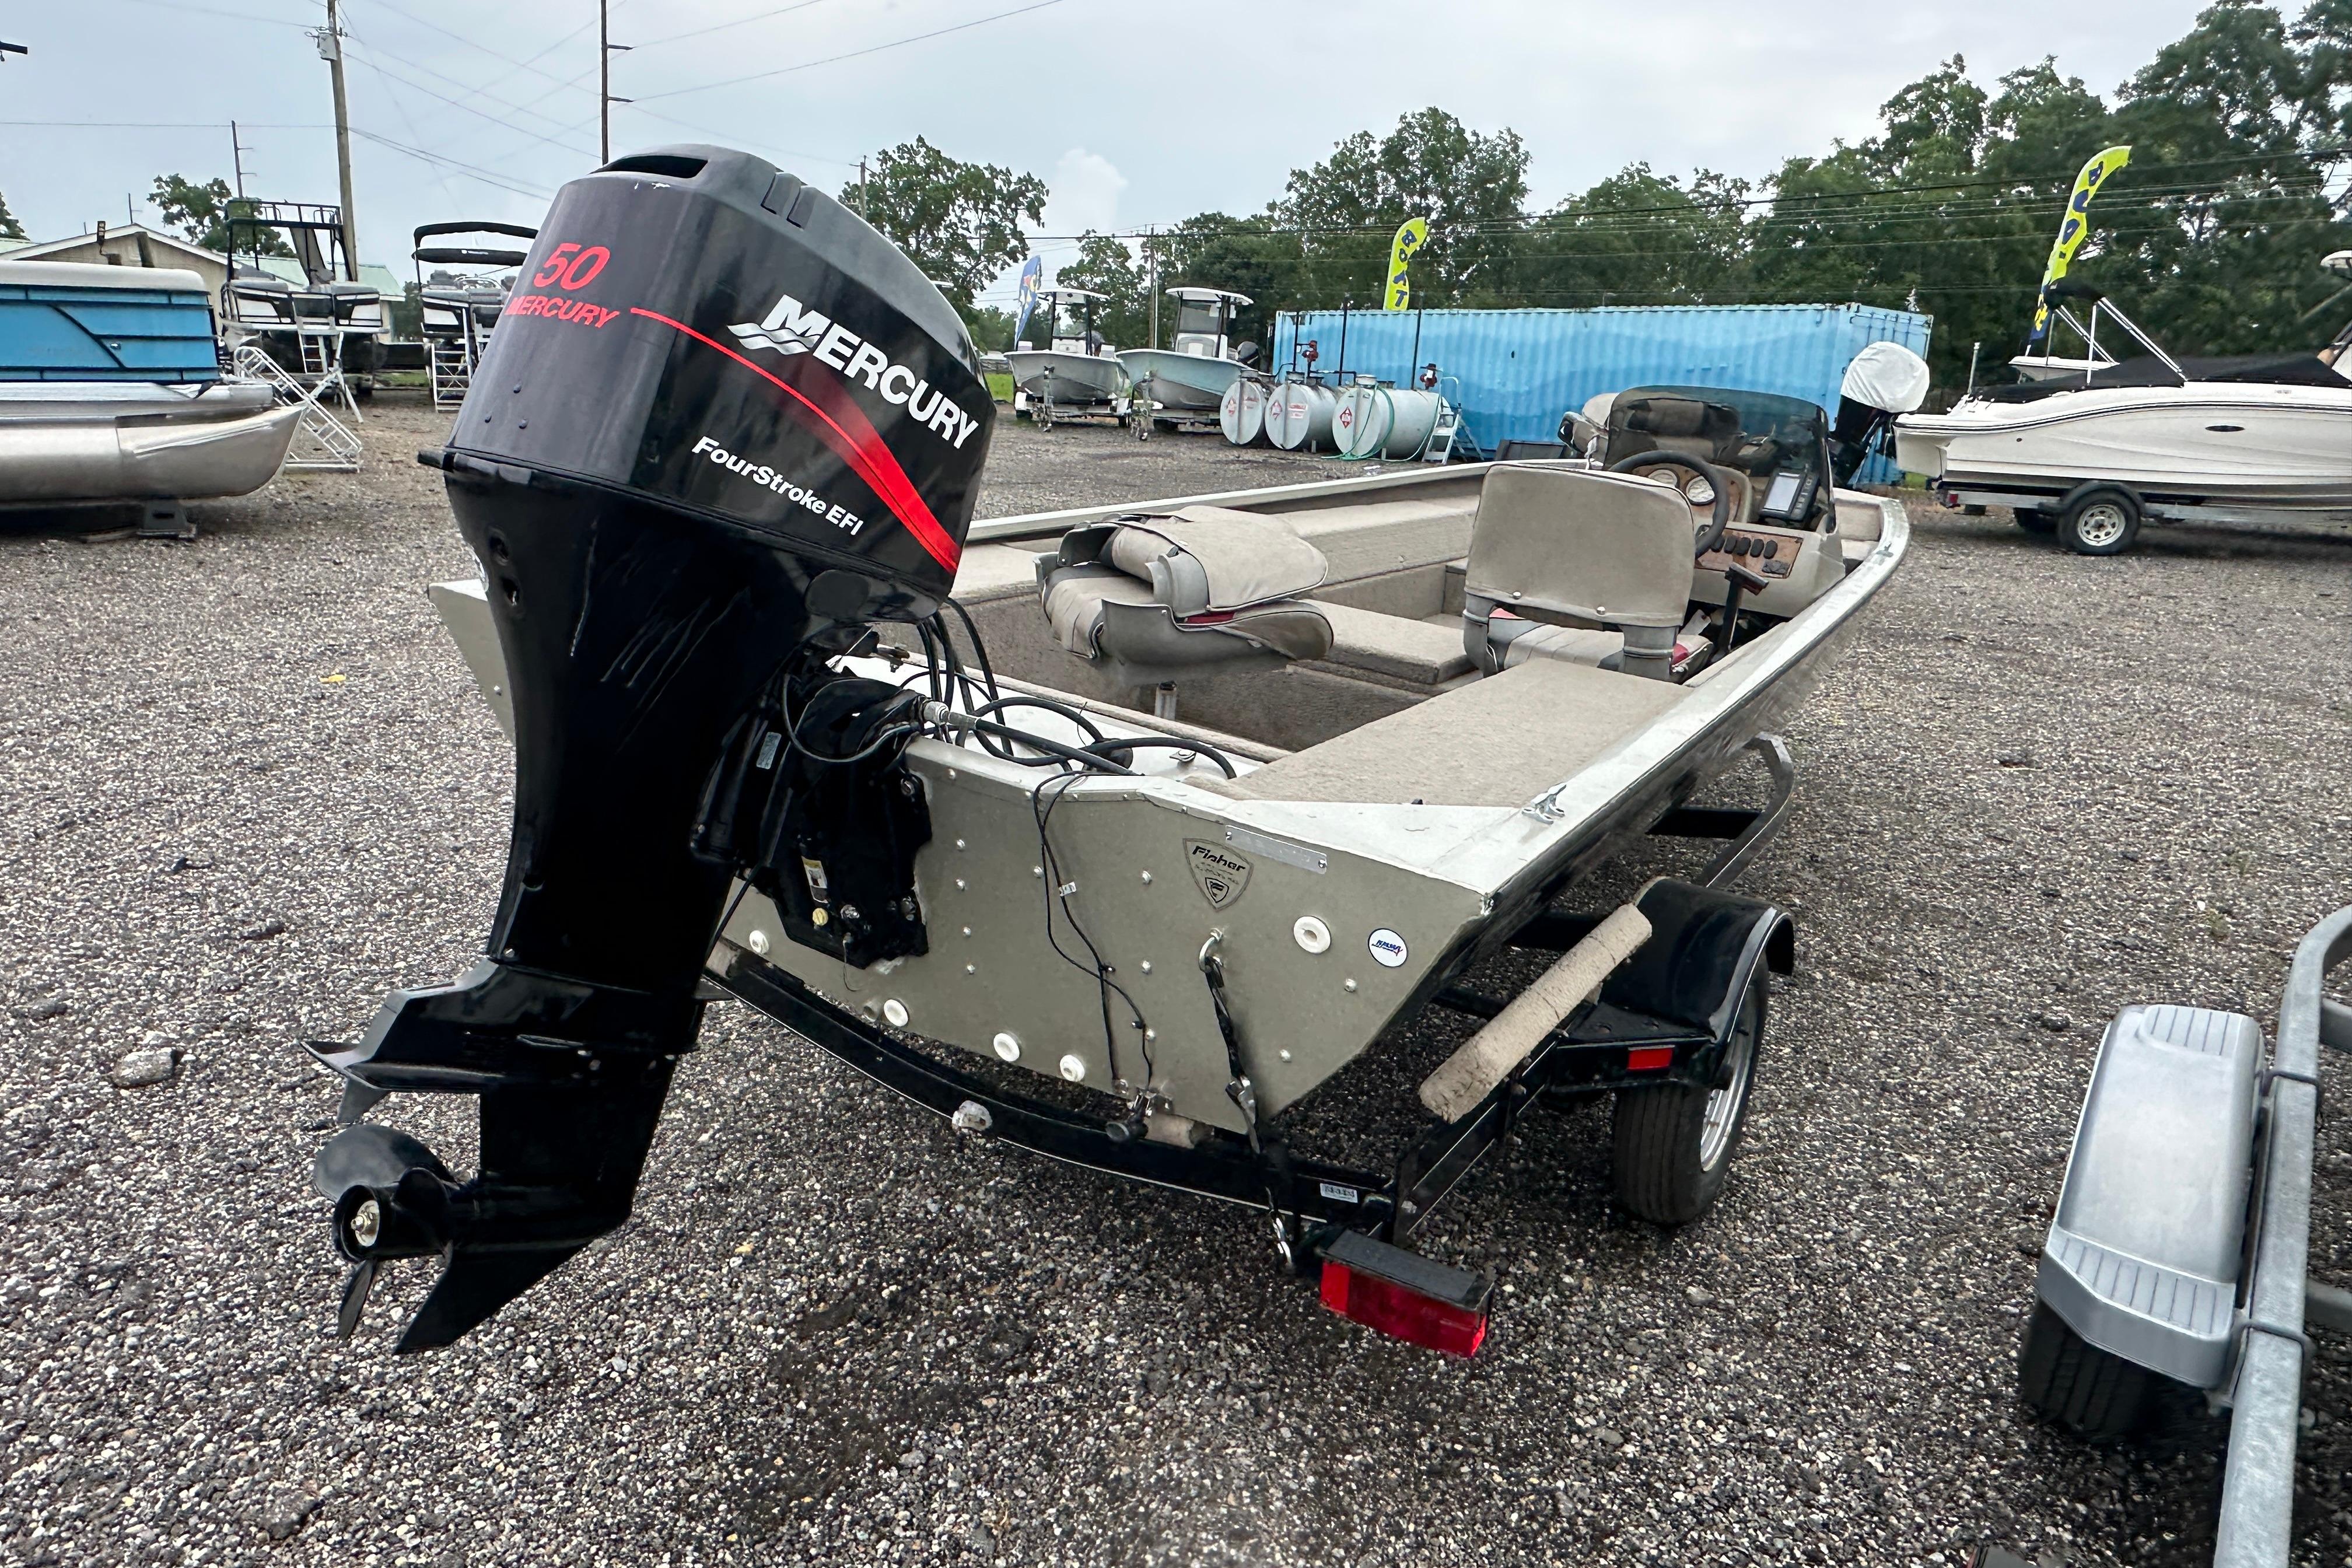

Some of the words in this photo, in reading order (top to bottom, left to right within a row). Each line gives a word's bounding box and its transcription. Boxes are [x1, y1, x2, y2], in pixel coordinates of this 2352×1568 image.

[533, 243, 611, 290] 50
[1392, 229, 1418, 307] BOAT
[505, 295, 620, 328] MERCURY
[760, 293, 979, 449] MERCURY
[691, 436, 827, 514] FourStroke
[825, 504, 864, 536] EFI
